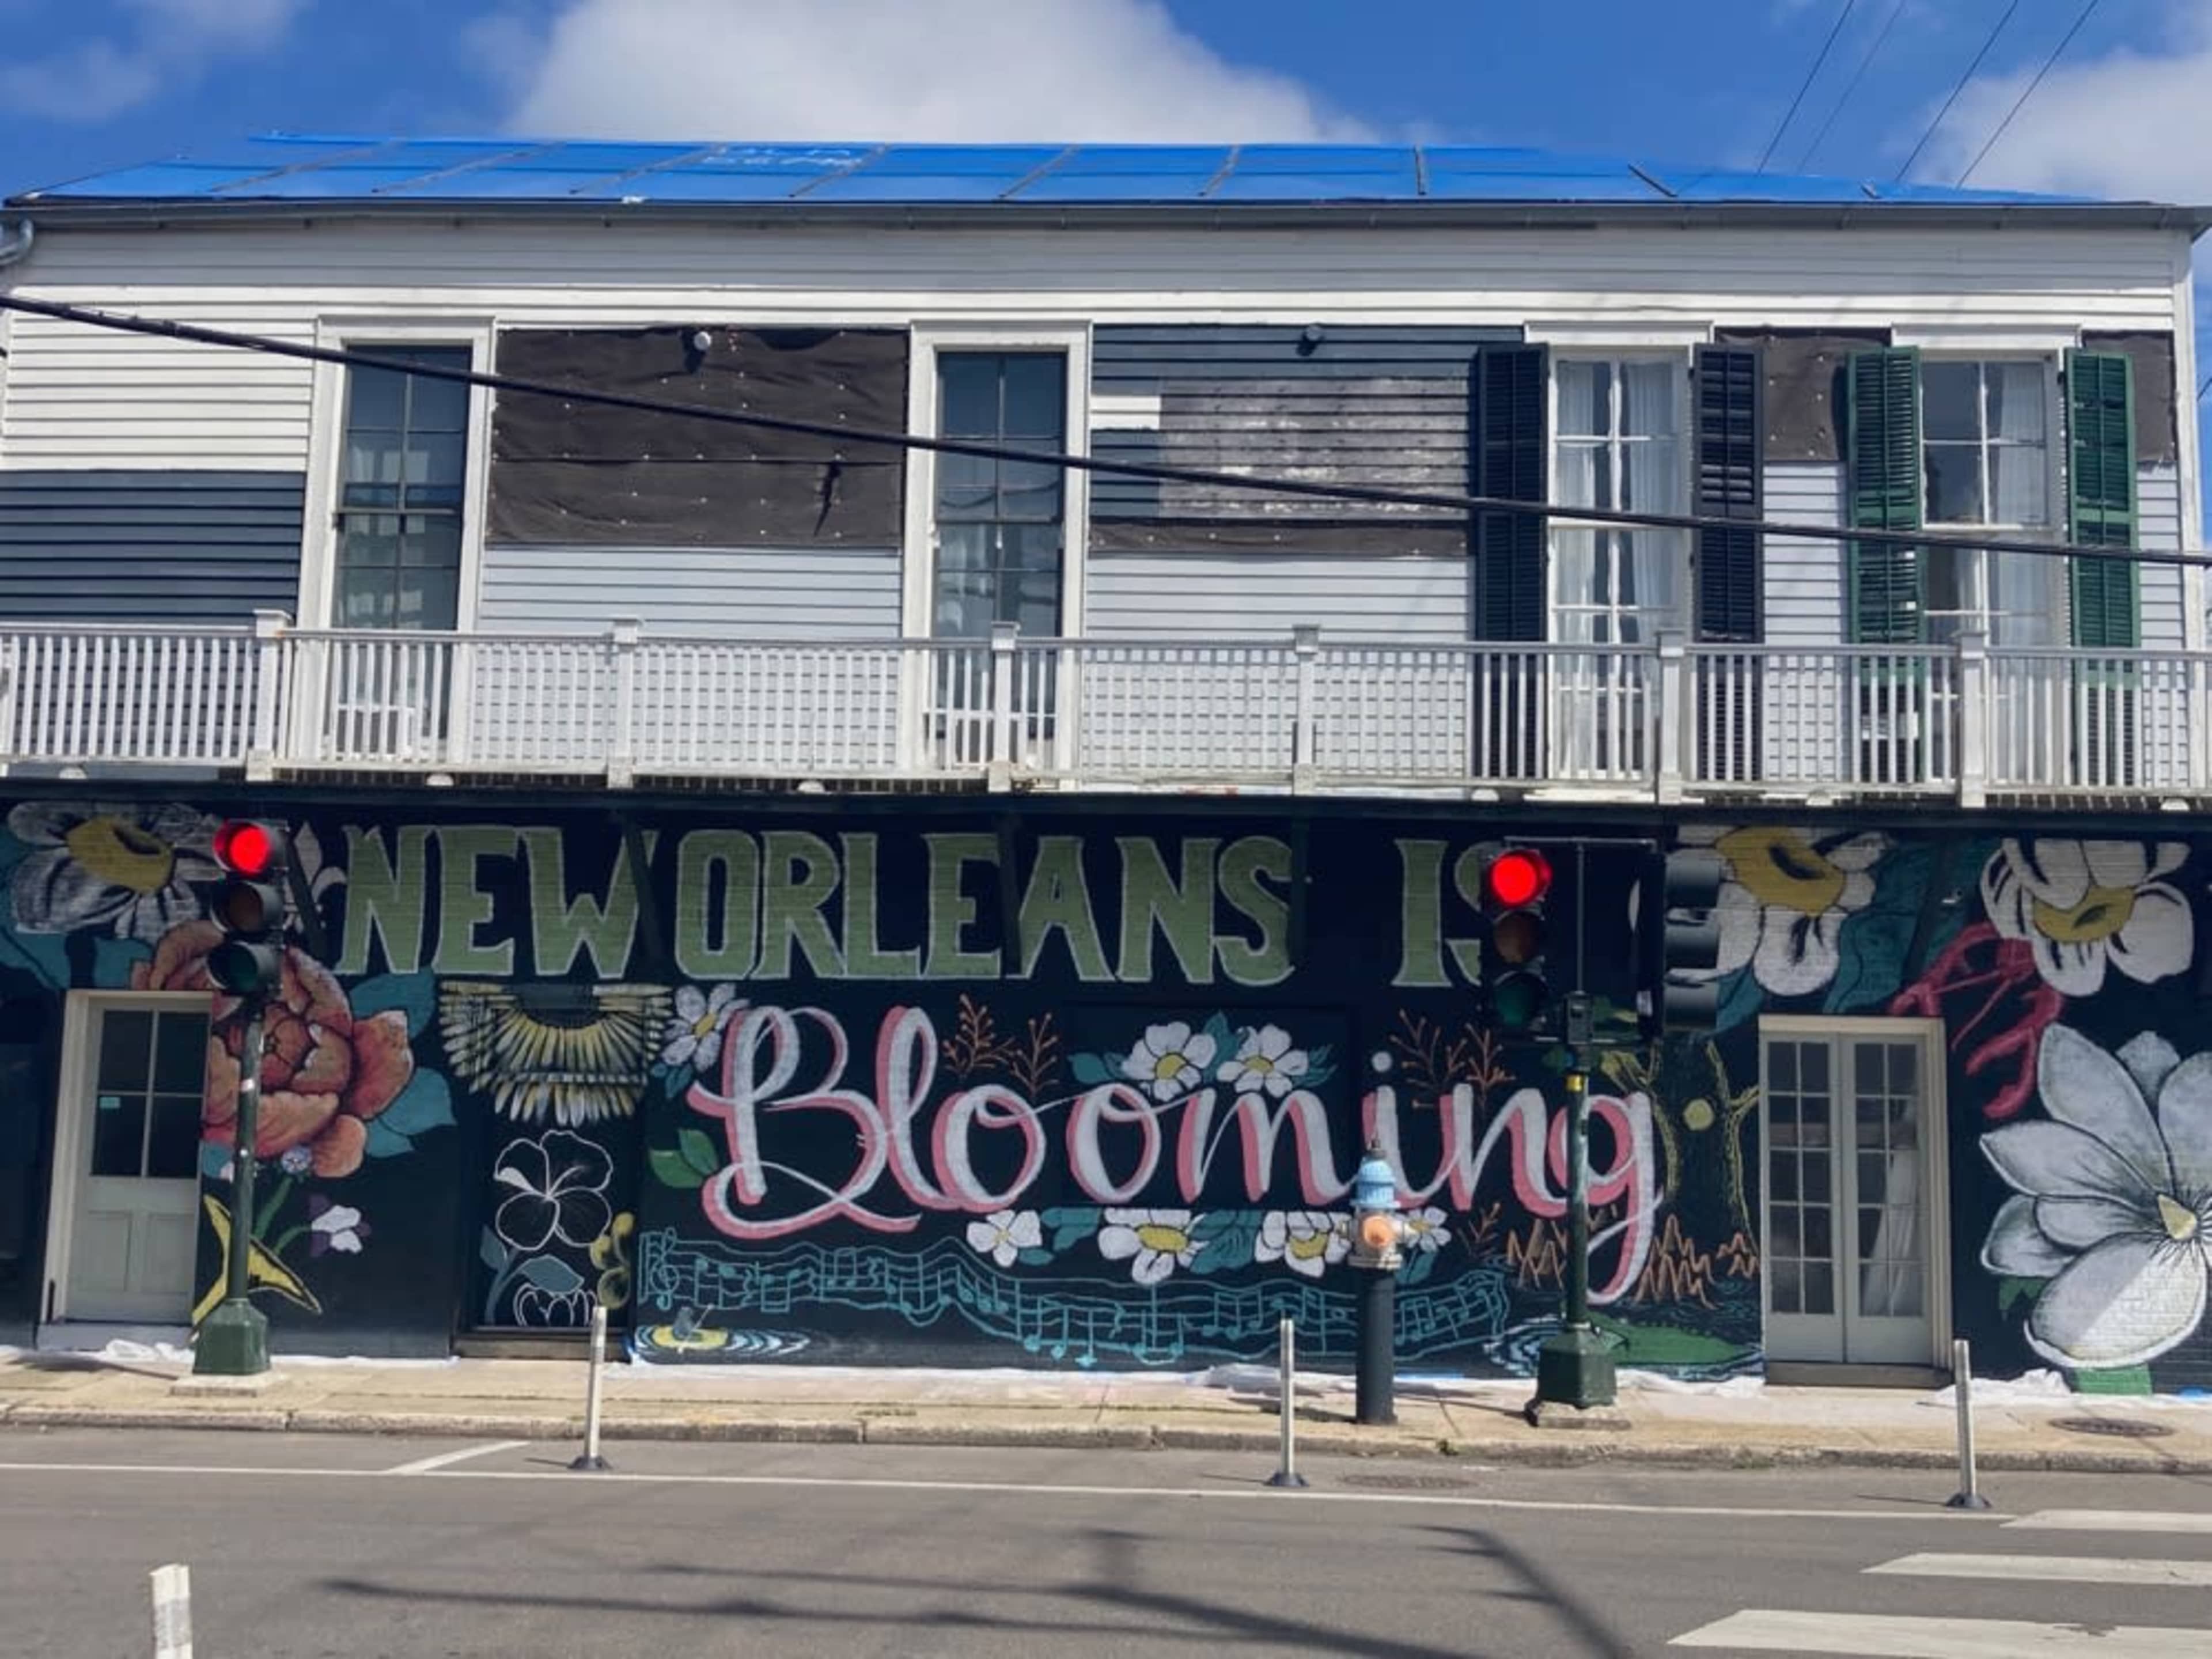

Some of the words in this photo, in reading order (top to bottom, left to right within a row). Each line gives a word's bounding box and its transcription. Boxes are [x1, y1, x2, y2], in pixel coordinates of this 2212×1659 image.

[333, 824, 659, 979] NEW
[674, 829, 1296, 987] ORLEANS
[685, 1004, 1665, 1306] Blooming
